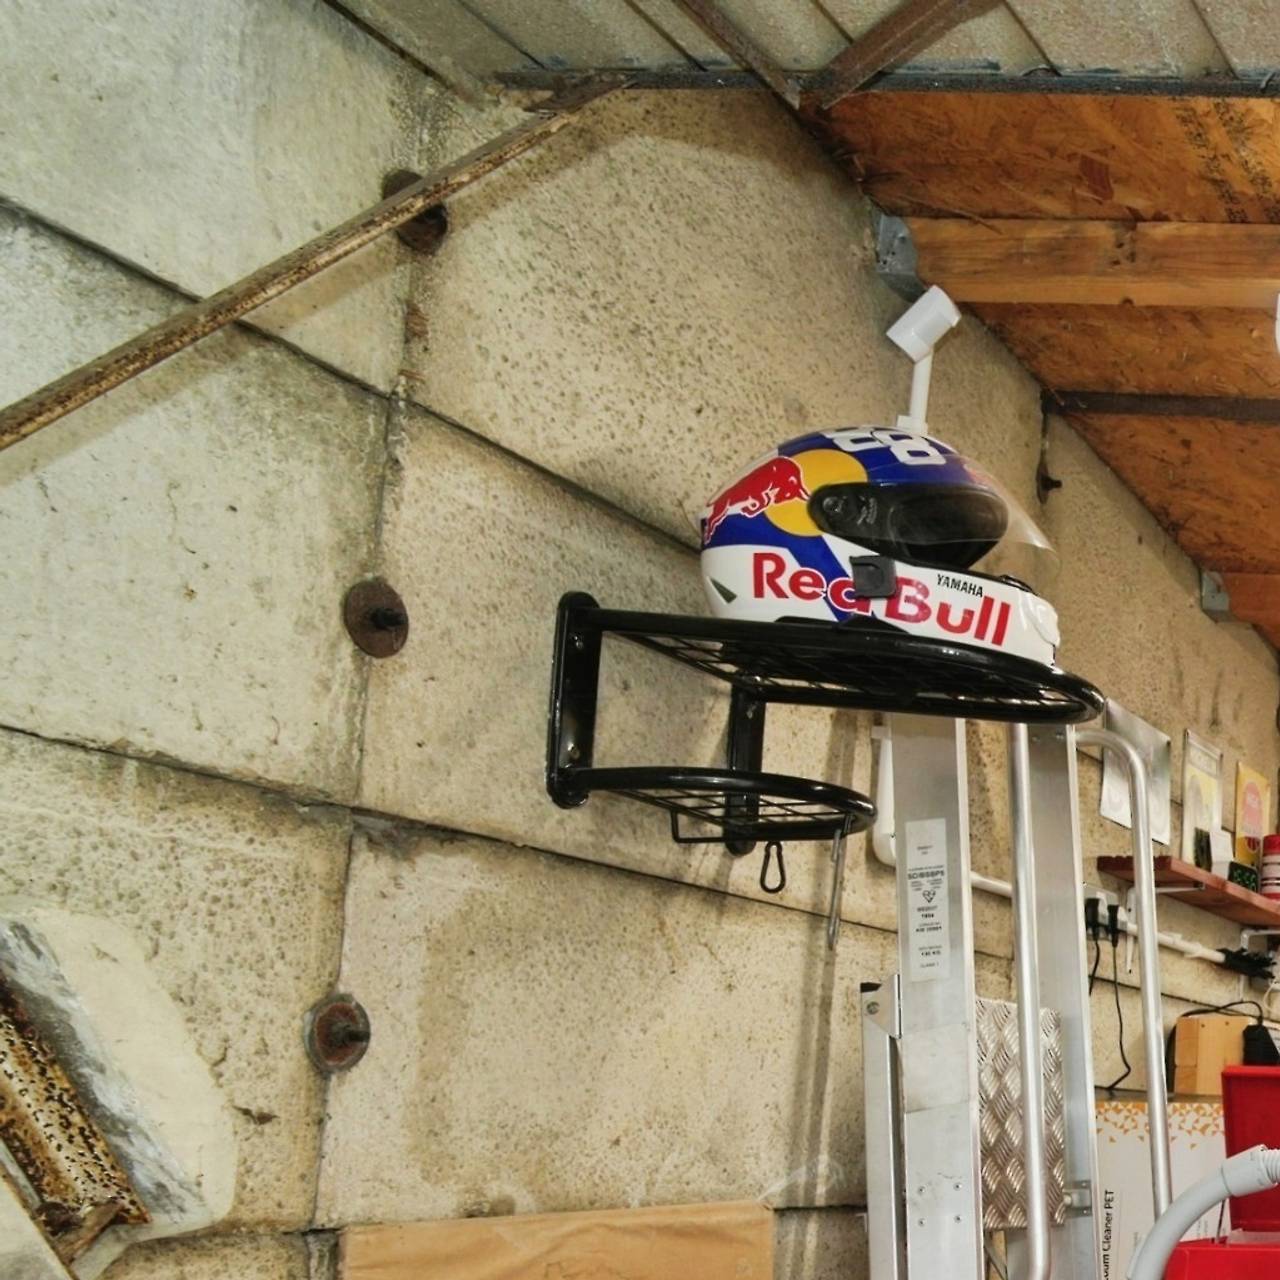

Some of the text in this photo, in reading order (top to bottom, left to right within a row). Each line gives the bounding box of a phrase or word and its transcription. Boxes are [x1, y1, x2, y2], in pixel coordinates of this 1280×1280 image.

[753, 552, 1011, 647] Red Bull
[937, 573, 984, 598] YAMAHA
[1104, 1189, 1115, 1210] PET
[1102, 1212, 1113, 1252] Cleaner
